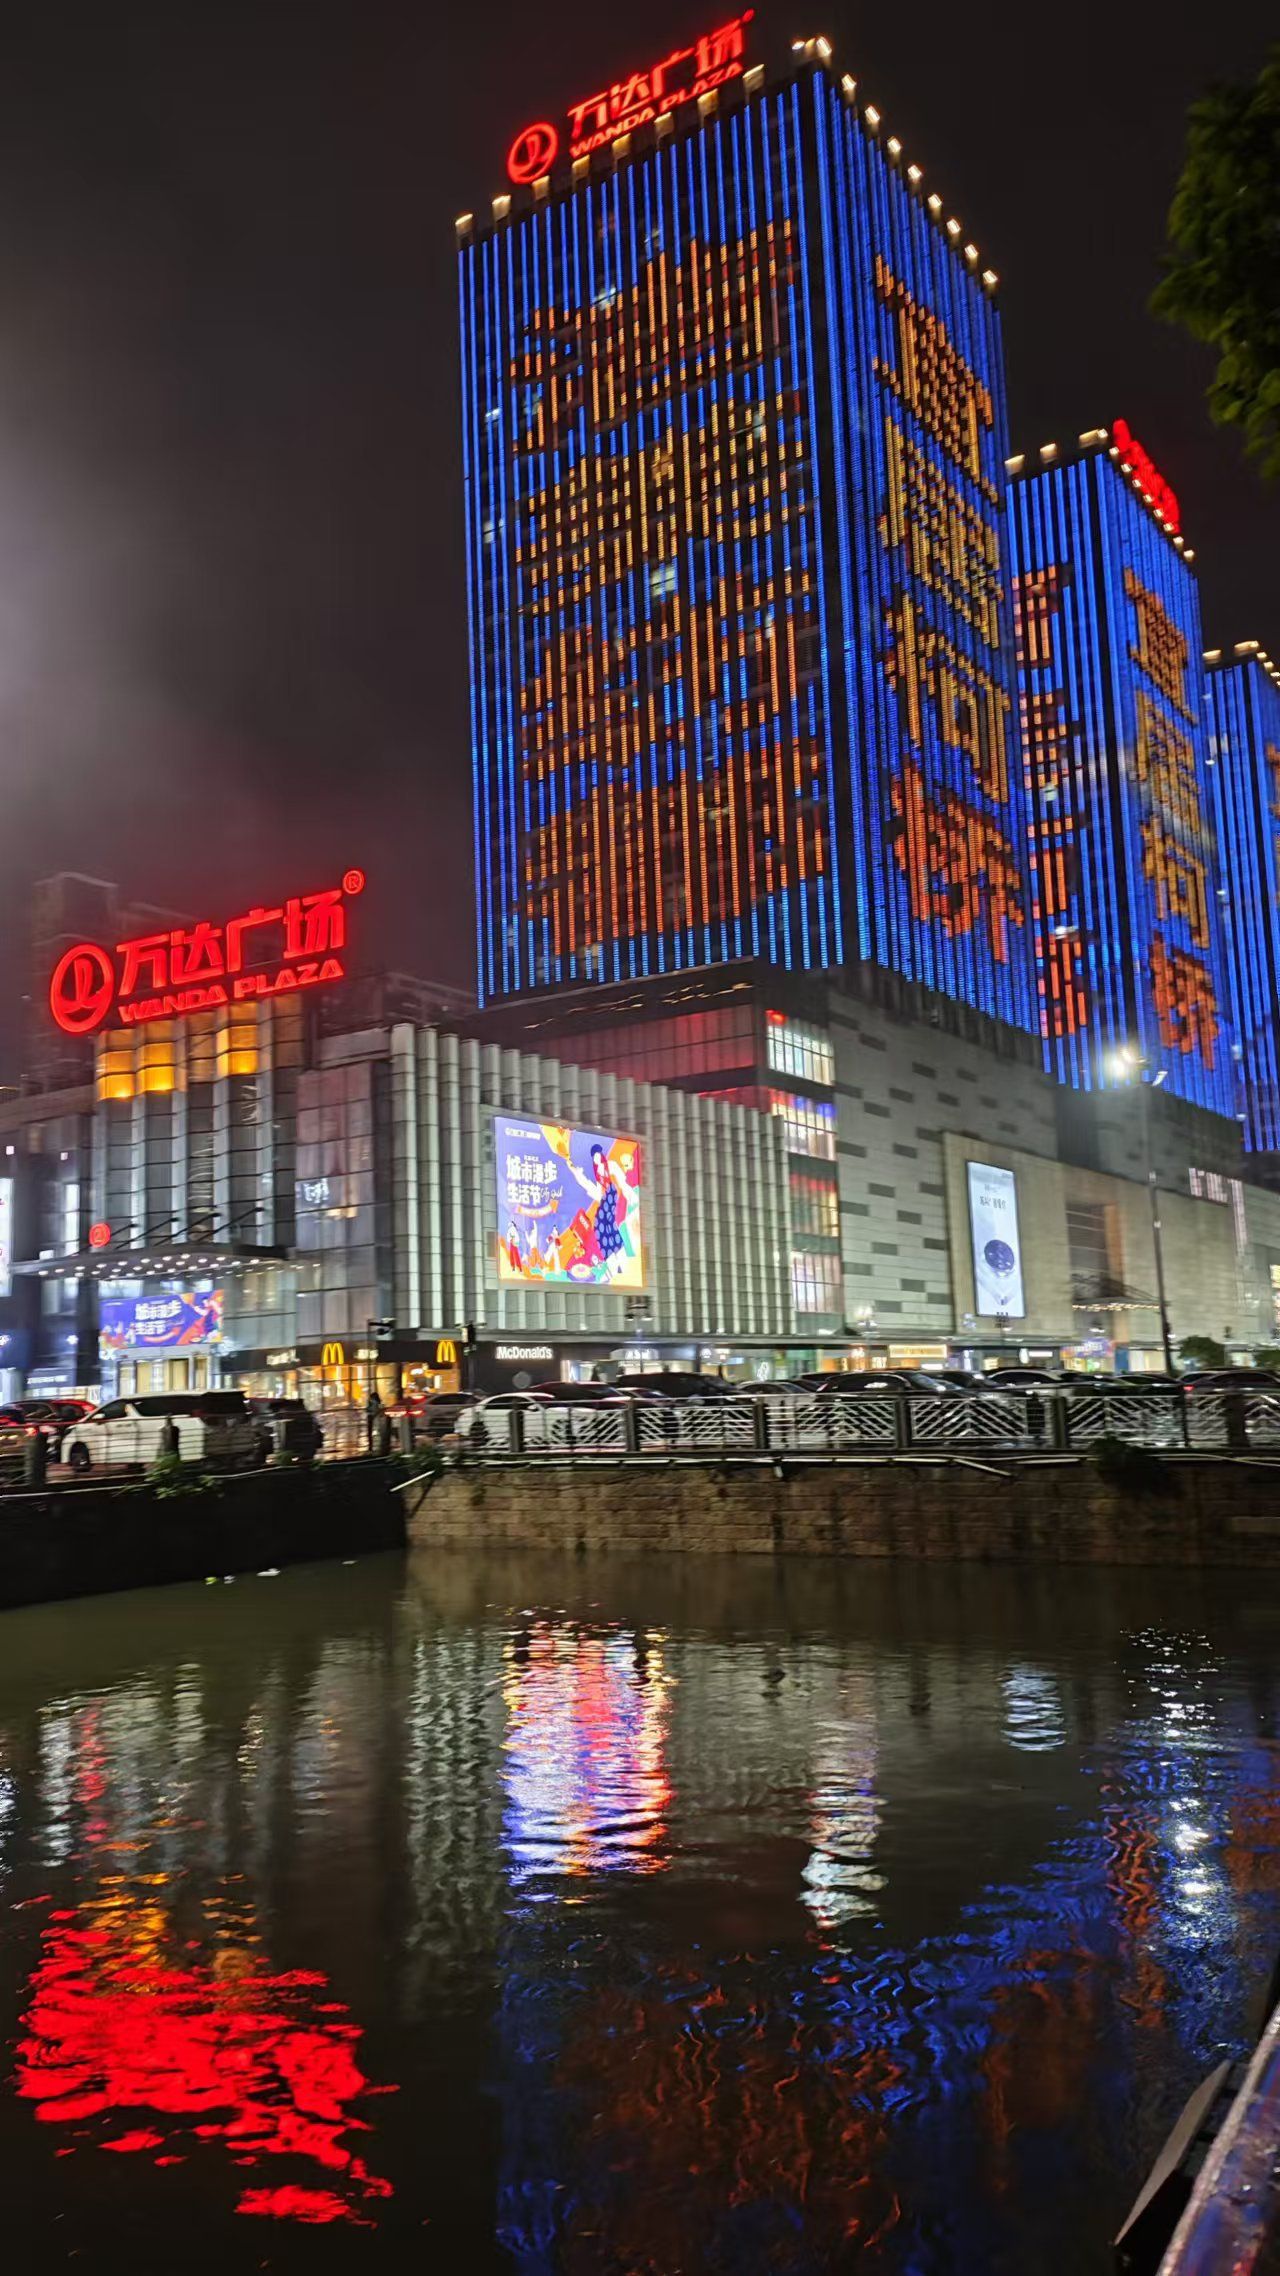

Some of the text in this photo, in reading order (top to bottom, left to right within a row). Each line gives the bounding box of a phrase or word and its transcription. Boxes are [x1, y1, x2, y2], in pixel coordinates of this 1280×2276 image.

[567, 19, 743, 138] 万达广场
[570, 61, 743, 157] WANDA PLAZA
[875, 254, 1024, 963] 宜居柯桥
[116, 889, 345, 996] 万达广场
[118, 959, 344, 1023] WANDA PLAZA
[506, 1154, 557, 1184] 城市漫步
[507, 1181, 541, 1206] 生活节
[496, 1347, 553, 1359] McDonald's
